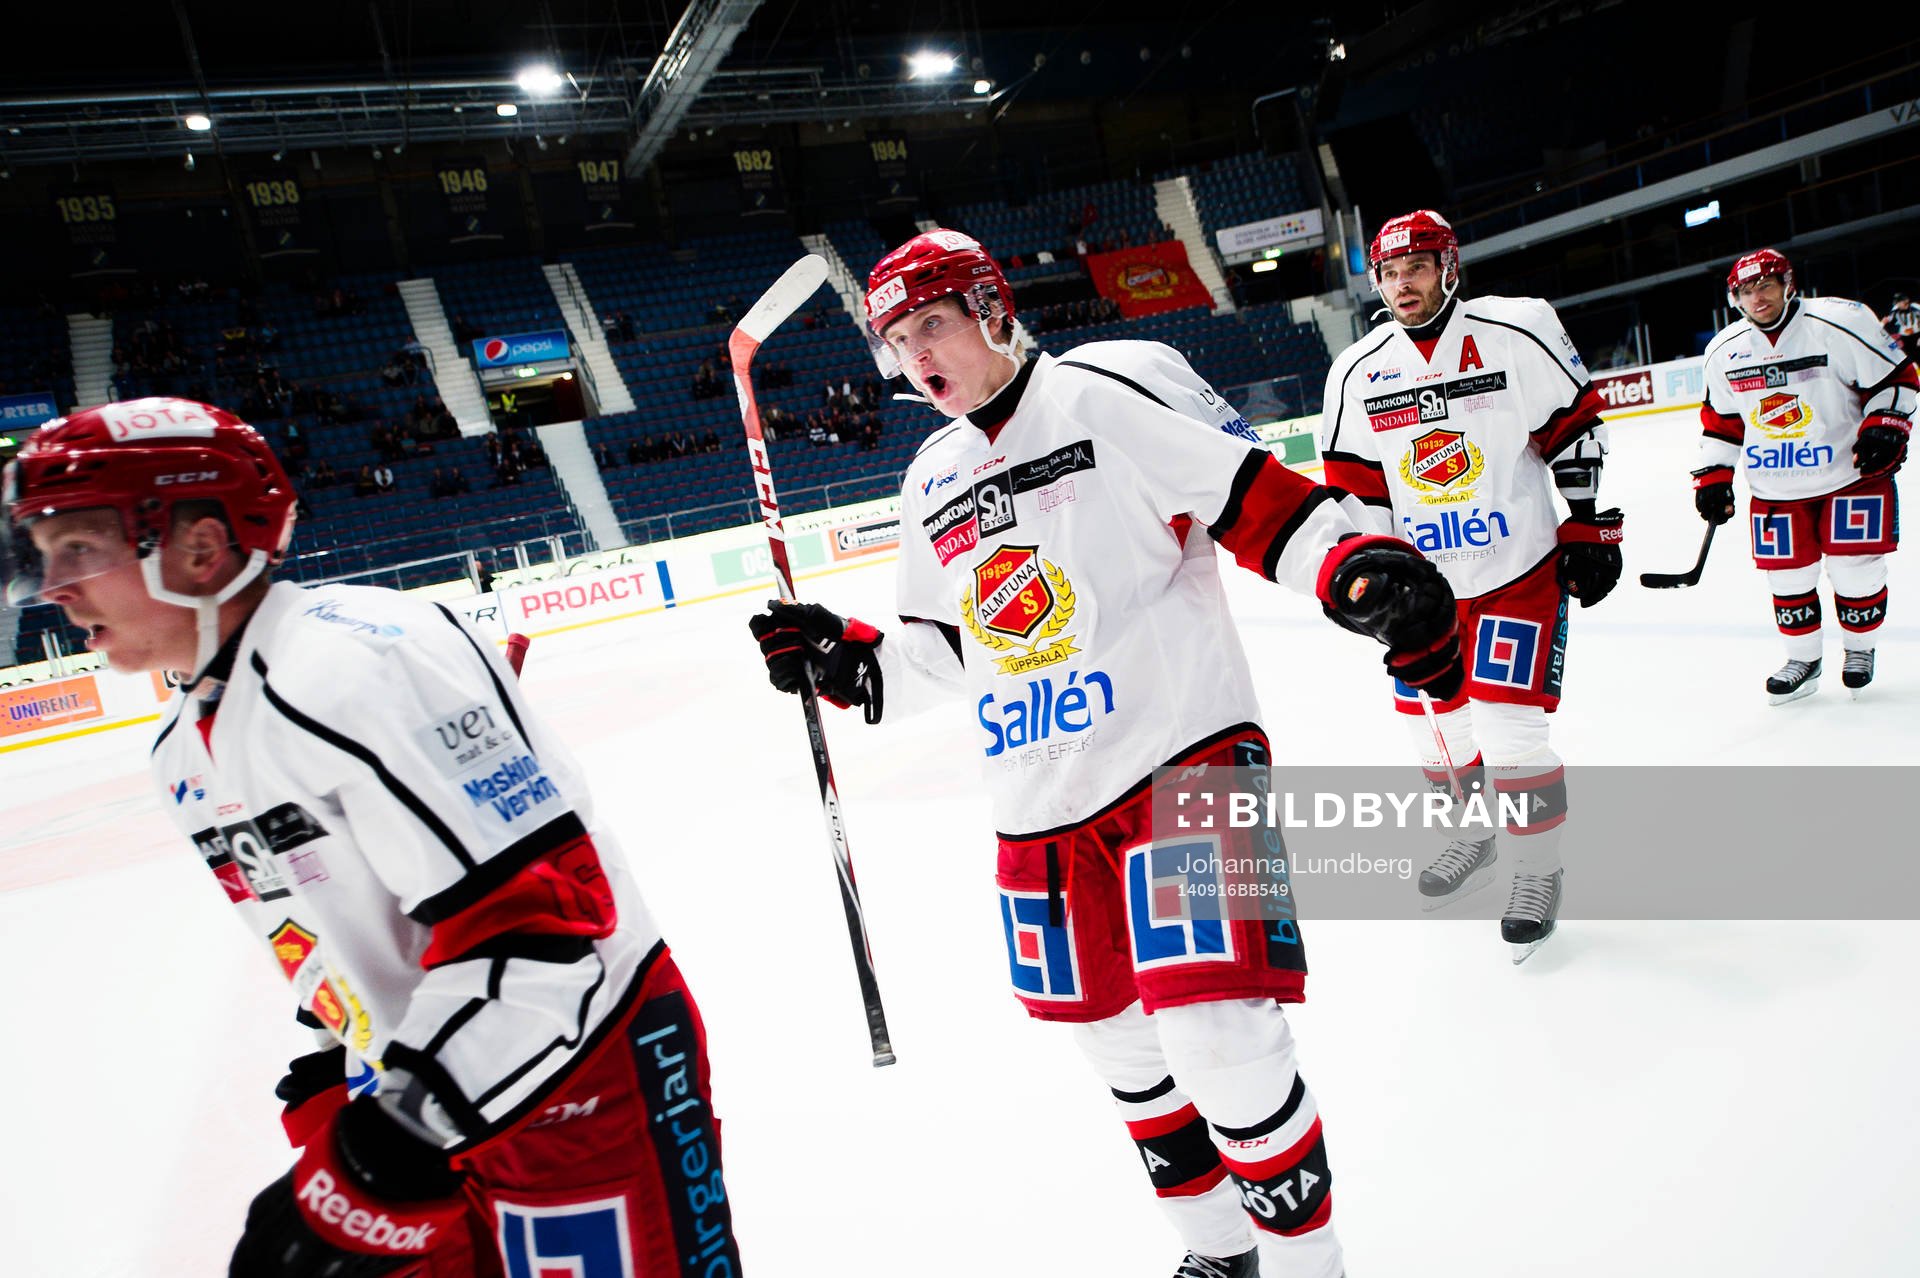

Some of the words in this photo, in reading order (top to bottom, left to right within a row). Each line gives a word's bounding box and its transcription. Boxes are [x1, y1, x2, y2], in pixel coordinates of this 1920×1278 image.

[733, 149, 774, 173] 1982
[870, 139, 908, 162] 1984
[438, 168, 488, 194] 1946
[578, 160, 619, 183] 1947
[245, 180, 300, 207] 1938
[56, 194, 116, 223] 1935
[511, 340, 553, 357] pepsi
[1459, 334, 1484, 373] A
[1415, 371, 1444, 382] CCM
[1366, 393, 1415, 412] MARKONA
[1422, 410, 1444, 419] BYGG
[1419, 442, 1429, 450] 19
[1434, 439, 1445, 448] 32
[1747, 441, 1833, 469] Sallén
[973, 455, 1007, 476] CCM
[1415, 442, 1462, 474] ALMTUNA
[1446, 457, 1459, 475] S
[155, 471, 218, 485] CCM
[936, 471, 958, 488] SPORT
[977, 484, 1012, 523] Sh
[1428, 495, 1466, 505] UPPSALA
[926, 497, 975, 537] MARKONA
[983, 513, 1011, 529] BYGG
[981, 567, 995, 580] 19
[1000, 561, 1013, 574] 32
[520, 572, 645, 619] PROACT
[980, 563, 1037, 621] ALMTUNA
[1020, 589, 1039, 615] S
[1010, 649, 1063, 673] UPPSALA
[10, 693, 80, 721] UNIRENT
[978, 671, 1115, 757] Sallén
[1227, 1136, 1270, 1149] CCM
[297, 1168, 437, 1250] Reebok
